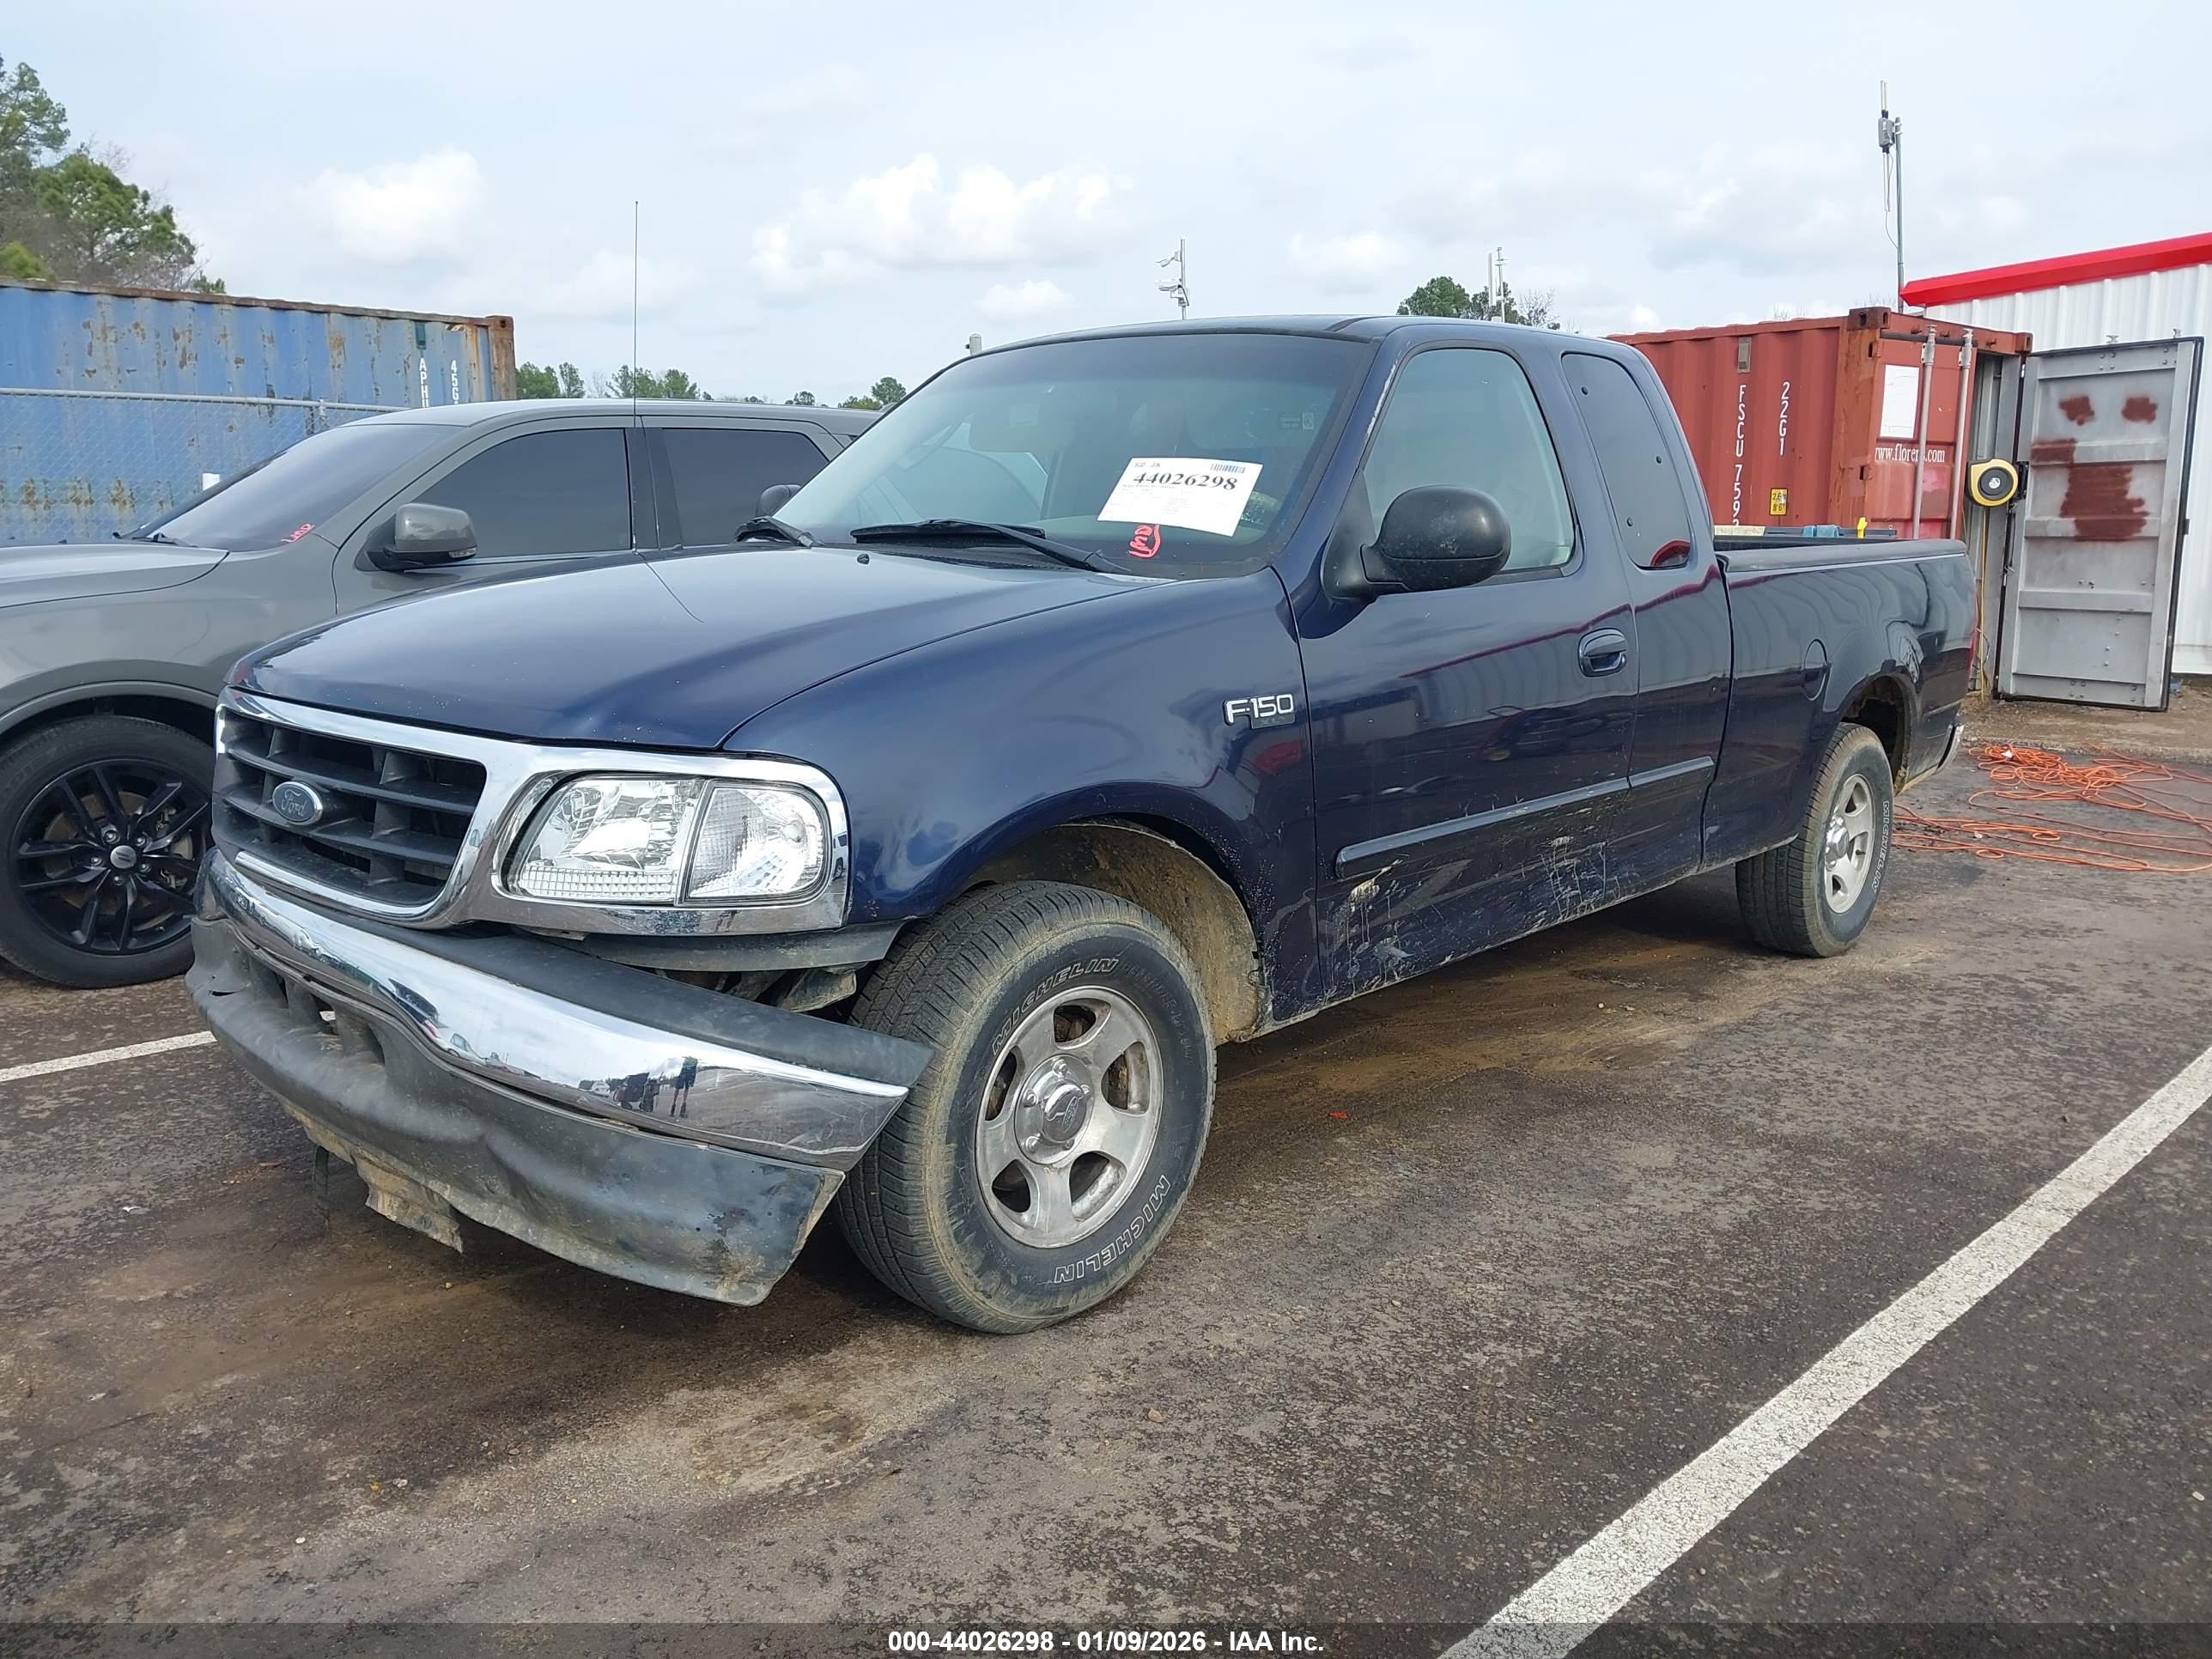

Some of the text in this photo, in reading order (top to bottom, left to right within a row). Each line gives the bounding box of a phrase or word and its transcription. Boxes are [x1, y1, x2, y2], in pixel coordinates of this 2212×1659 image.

[451, 359, 460, 405] 45G
[1735, 384, 1747, 458] FSCU
[1778, 381, 1791, 456] 22G1
[1133, 471, 1238, 490] 44026298
[1875, 443, 1946, 463] ww.flore.com
[1225, 693, 1294, 724] F-150
[281, 788, 308, 817] Ford
[1872, 800, 1891, 894] MICHELIN
[990, 957, 1121, 1057] MICHELIN
[1053, 1174, 1171, 1285] MICHELIN
